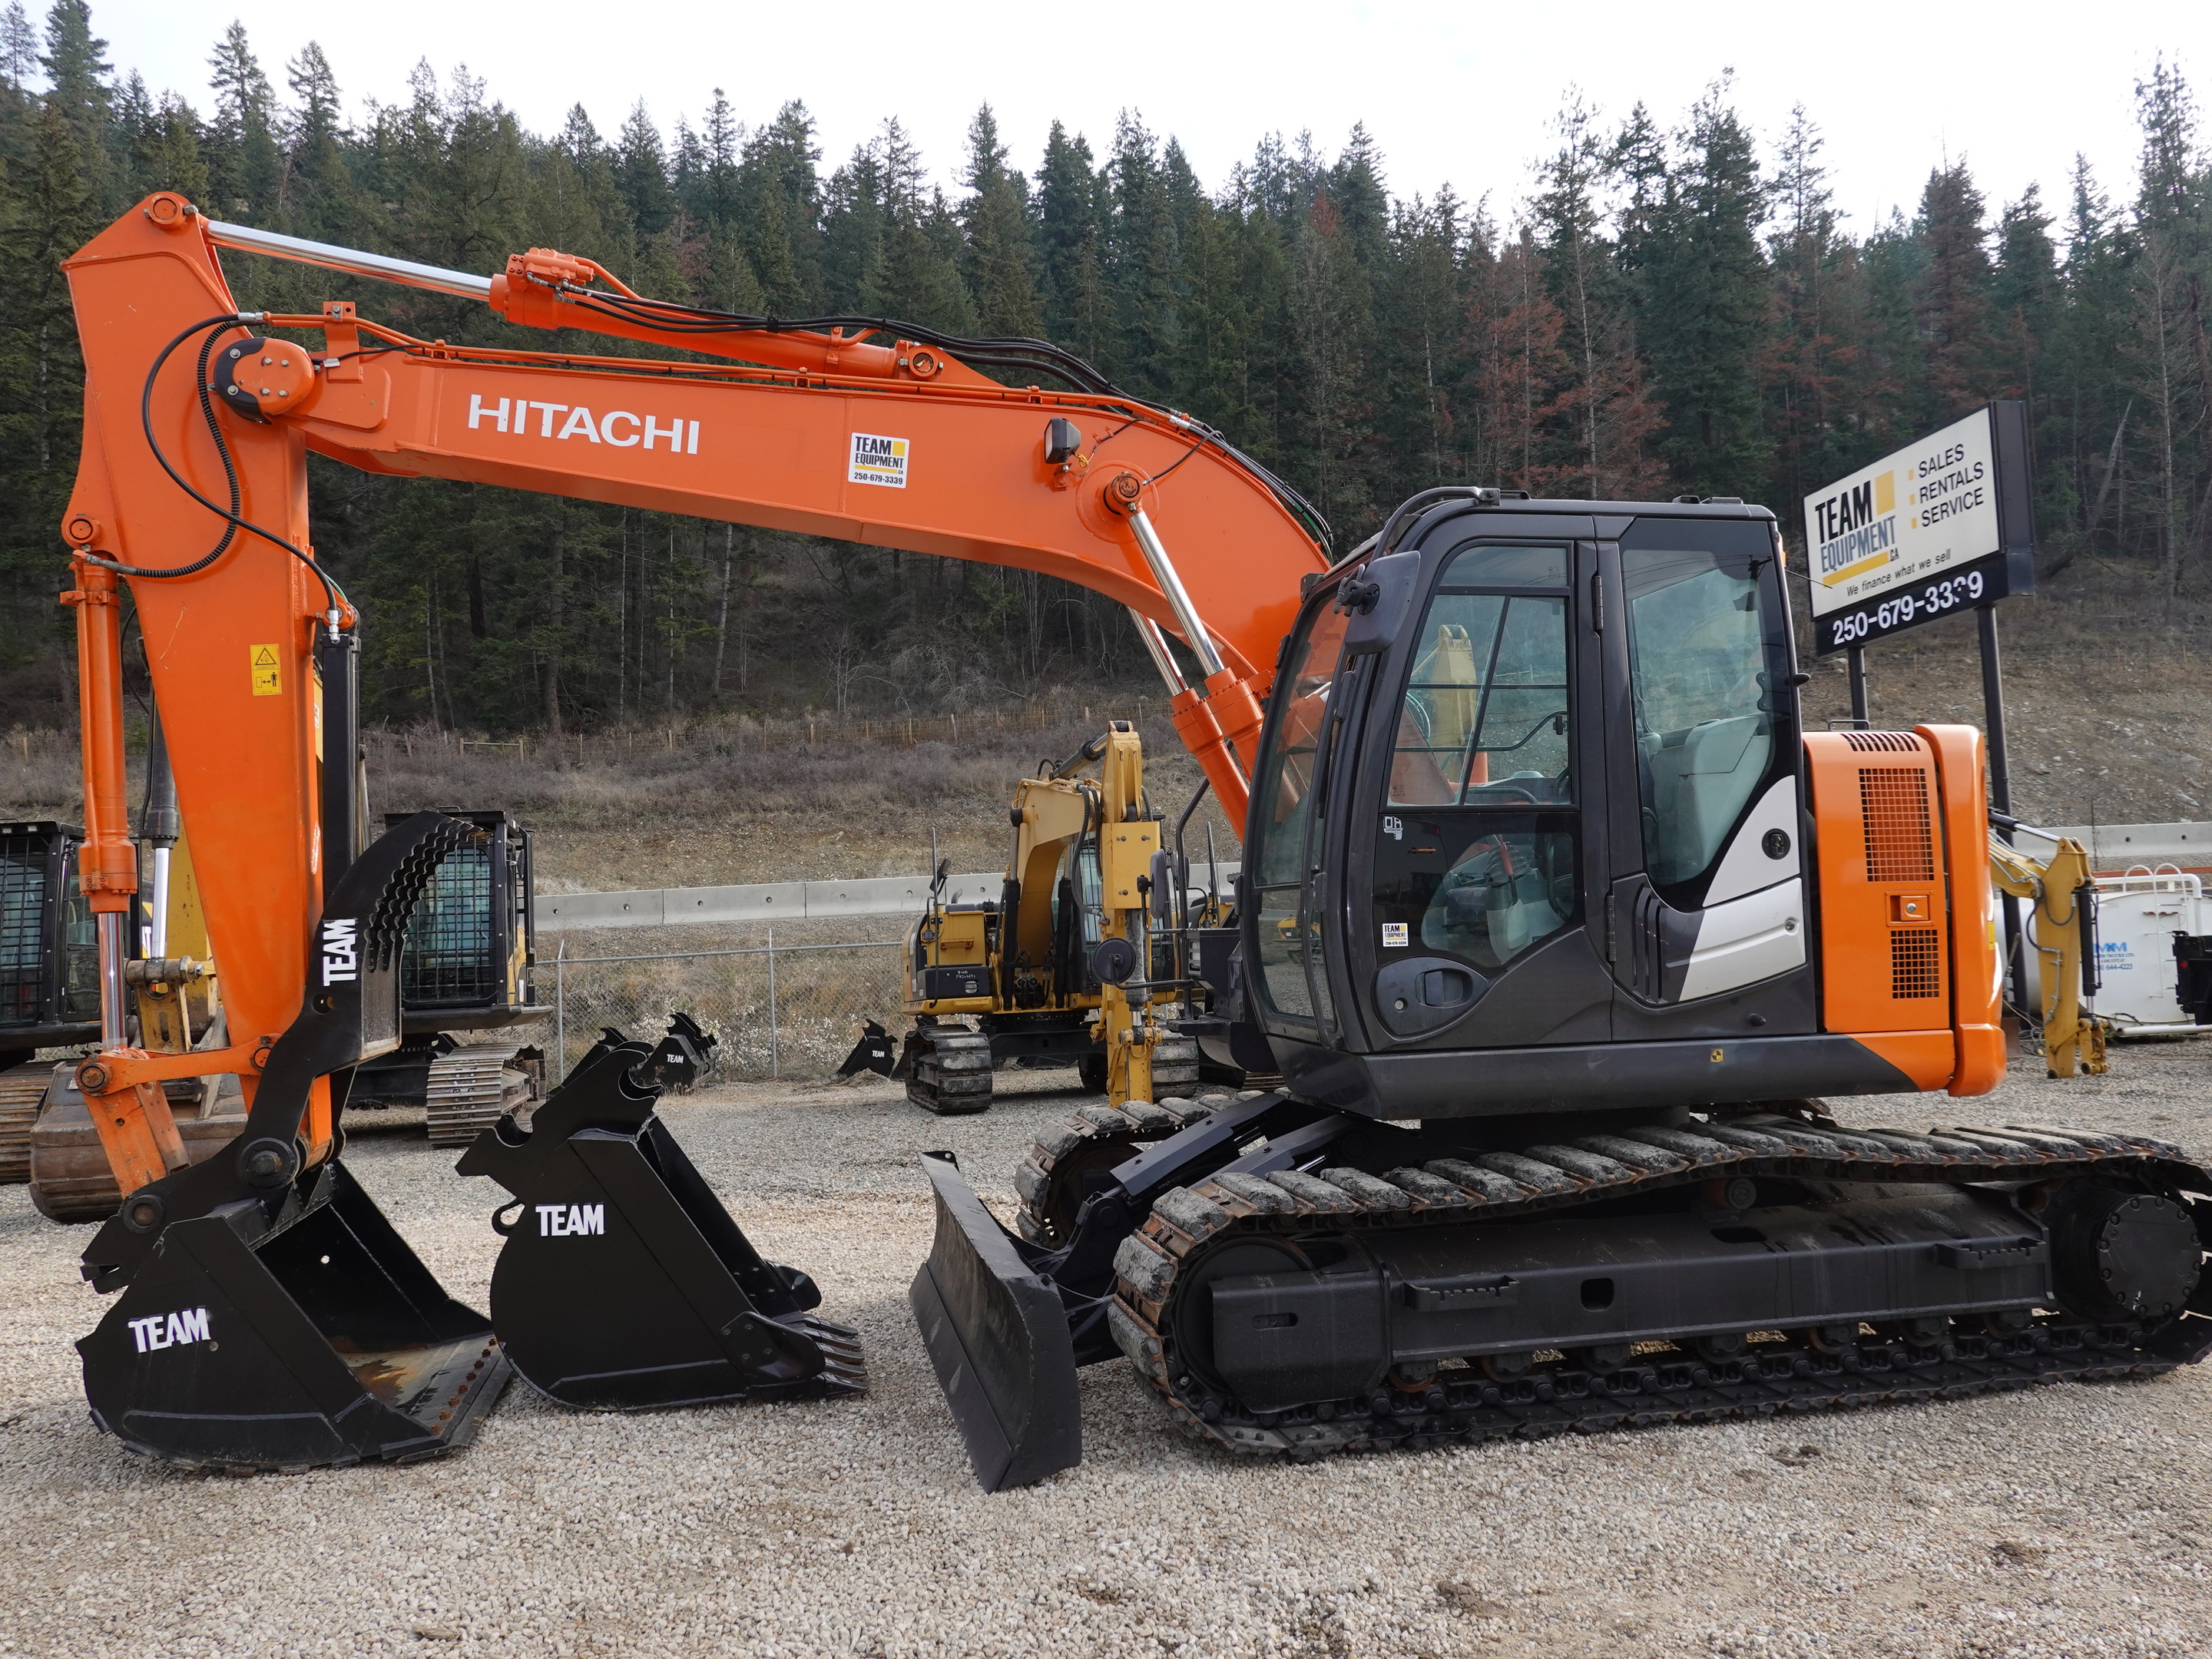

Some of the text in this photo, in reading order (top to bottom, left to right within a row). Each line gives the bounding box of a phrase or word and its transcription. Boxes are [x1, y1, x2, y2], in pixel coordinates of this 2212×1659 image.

[468, 393, 700, 455] HITACHI
[856, 436, 892, 455] TEAM
[856, 453, 904, 469] EQUIPMENT
[1918, 443, 1965, 478] SALES
[854, 472, 903, 485] 250-679-3339
[1919, 461, 1984, 504] RENTALS
[1814, 479, 1873, 545] TEAM
[1921, 486, 1985, 528] SERVICE
[1820, 515, 1896, 573] EQUIPMENT
[1846, 548, 1952, 598] We finance what we sell
[323, 918, 357, 987] TEAM
[666, 1054, 684, 1064] TEAM
[872, 1049, 885, 1058] TEAM
[535, 1203, 605, 1237] TEAM
[127, 1307, 211, 1353] TEAM
